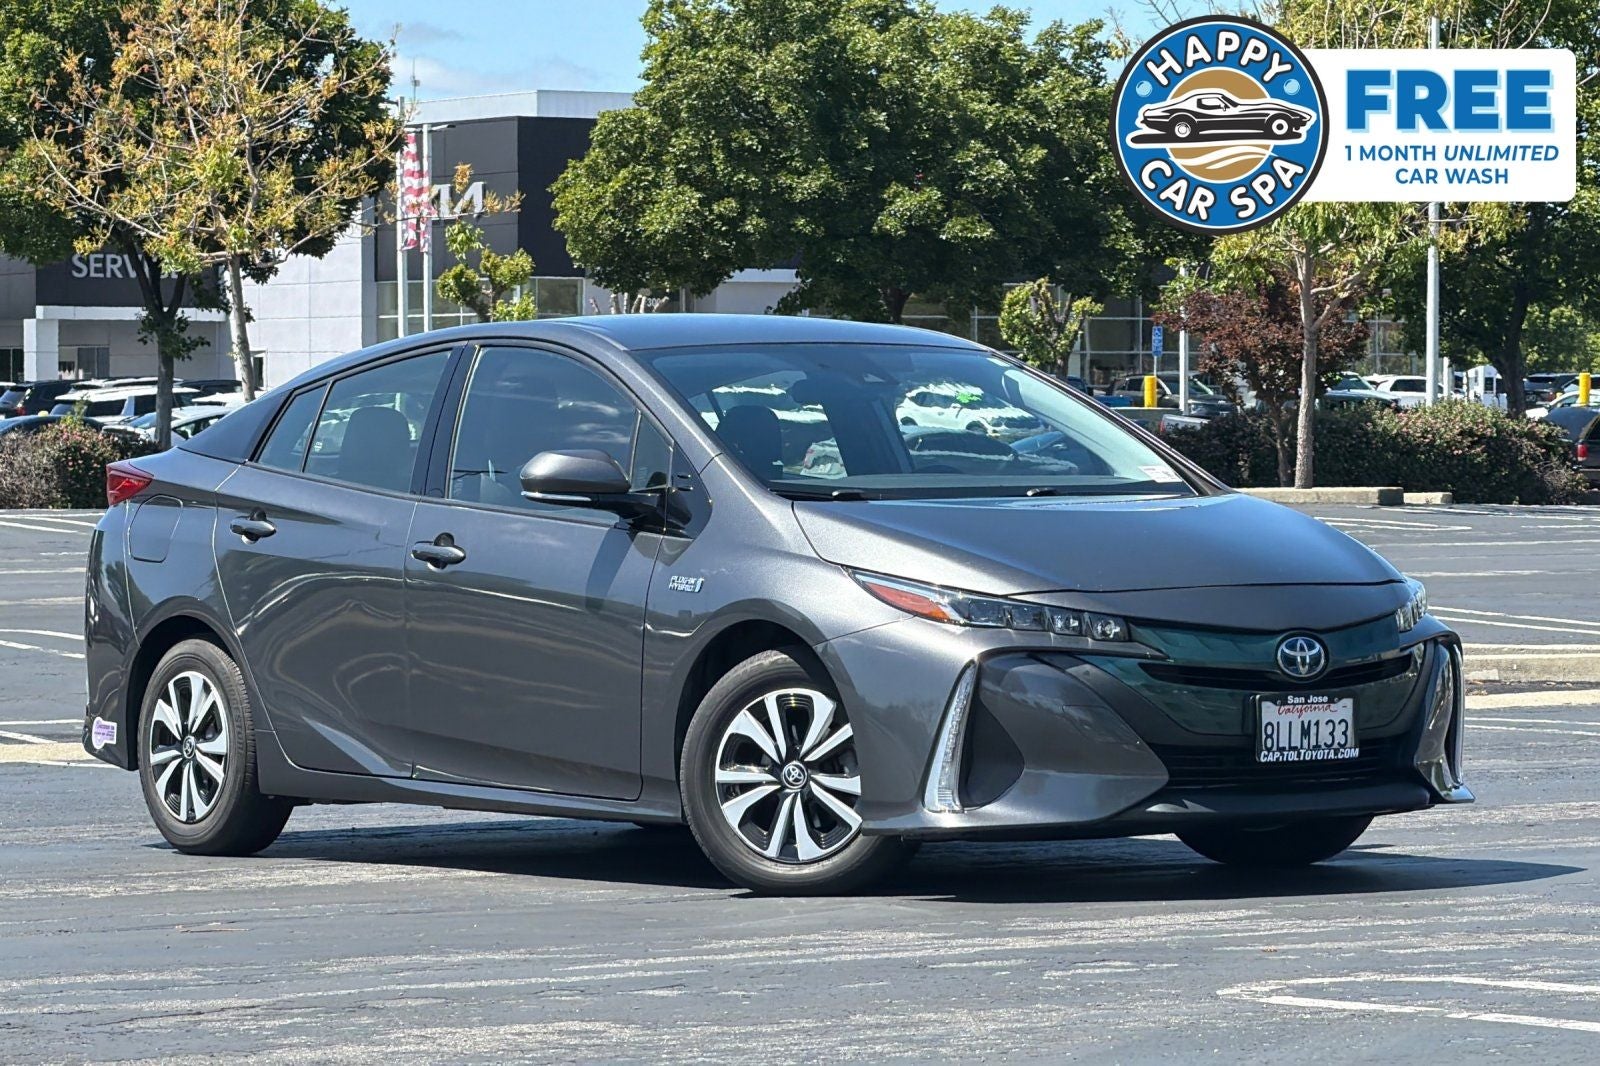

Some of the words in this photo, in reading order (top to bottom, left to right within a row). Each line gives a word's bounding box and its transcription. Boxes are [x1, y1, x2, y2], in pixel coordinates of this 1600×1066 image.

[1287, 695, 1305, 704] San
[1307, 694, 1329, 704] Jose
[1277, 703, 1337, 719] California
[1263, 718, 1349, 752] 8LLM133
